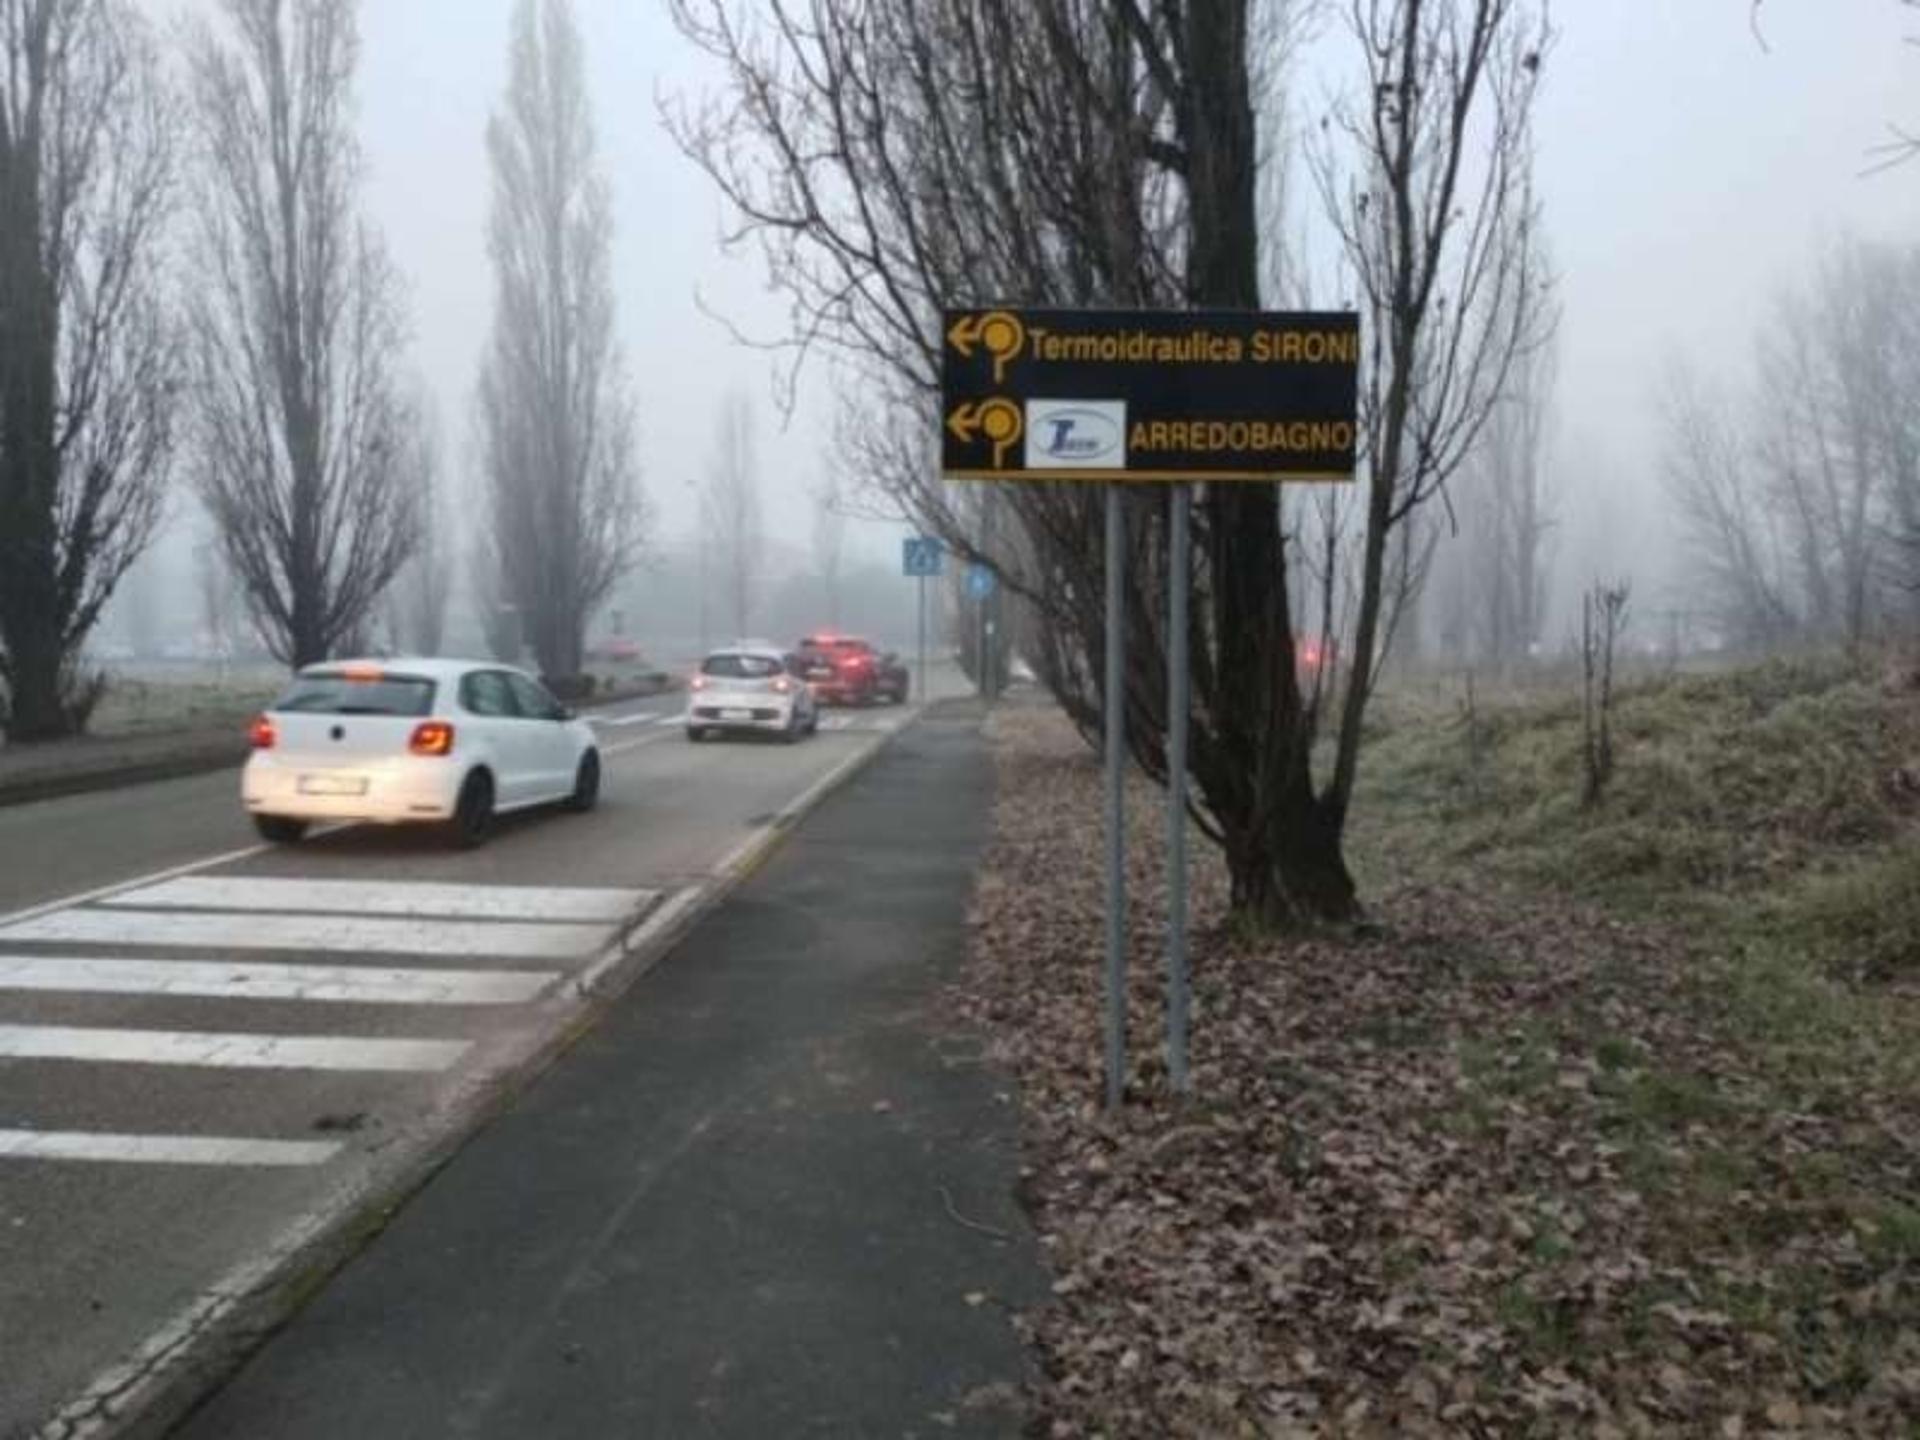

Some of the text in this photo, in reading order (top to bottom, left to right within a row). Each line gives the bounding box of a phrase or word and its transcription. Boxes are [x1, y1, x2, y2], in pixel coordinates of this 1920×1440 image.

[1029, 328, 1357, 363] Termoidraulica SIRONI
[1130, 421, 1352, 451] ARREDOBAGNO
